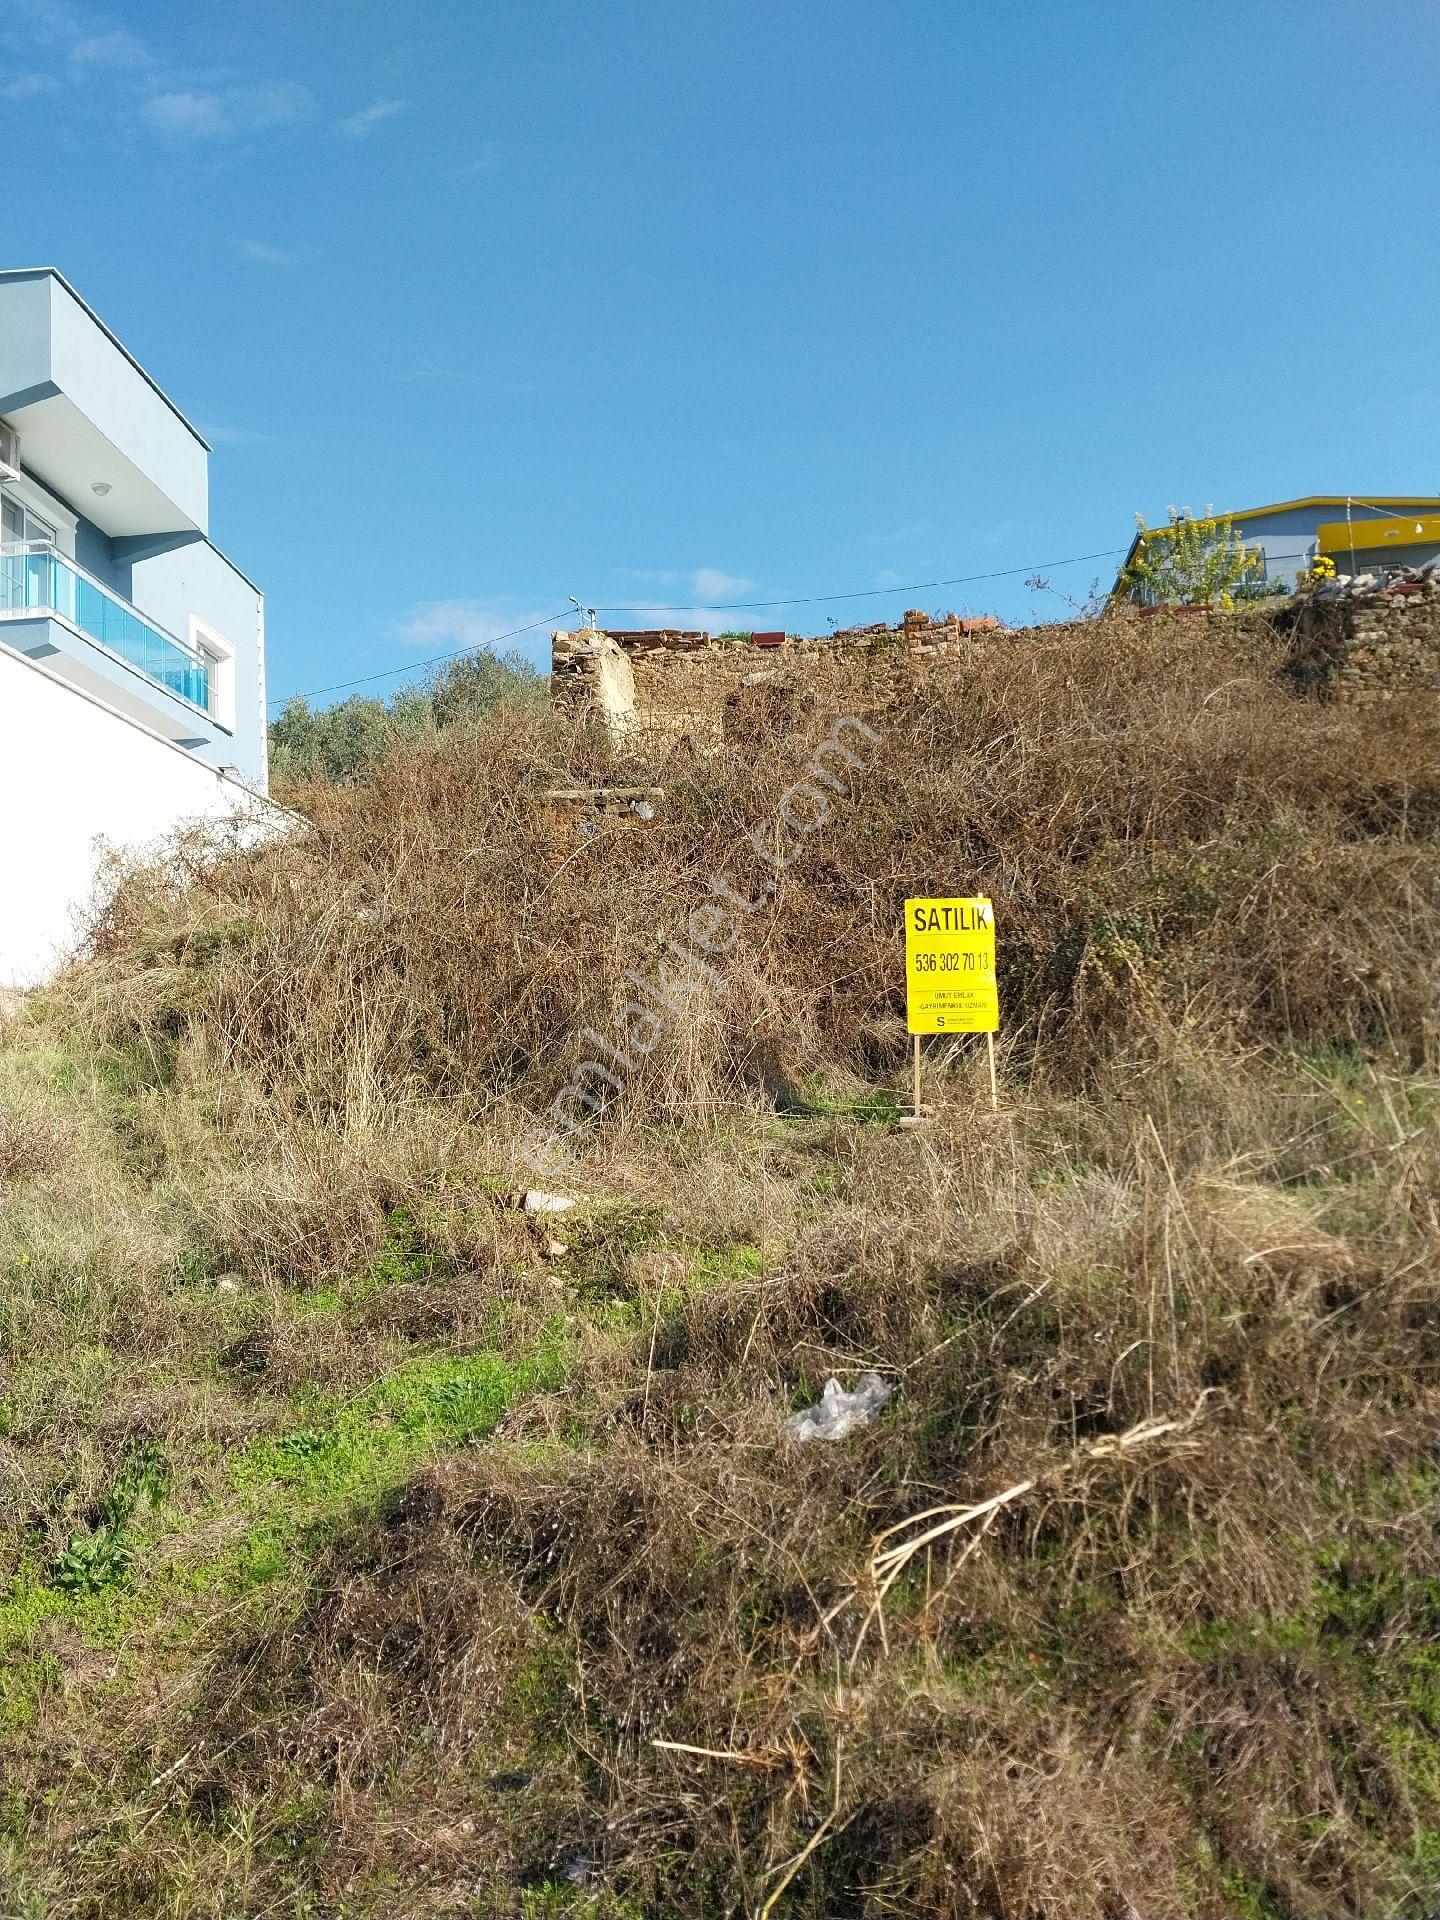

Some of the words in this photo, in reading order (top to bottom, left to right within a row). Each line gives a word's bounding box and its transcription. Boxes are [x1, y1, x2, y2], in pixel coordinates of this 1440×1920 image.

[914, 907, 988, 931] SATILIK
[915, 953, 937, 972] 536
[939, 953, 960, 971] 302
[962, 953, 975, 971] 70
[978, 952, 989, 970] 13
